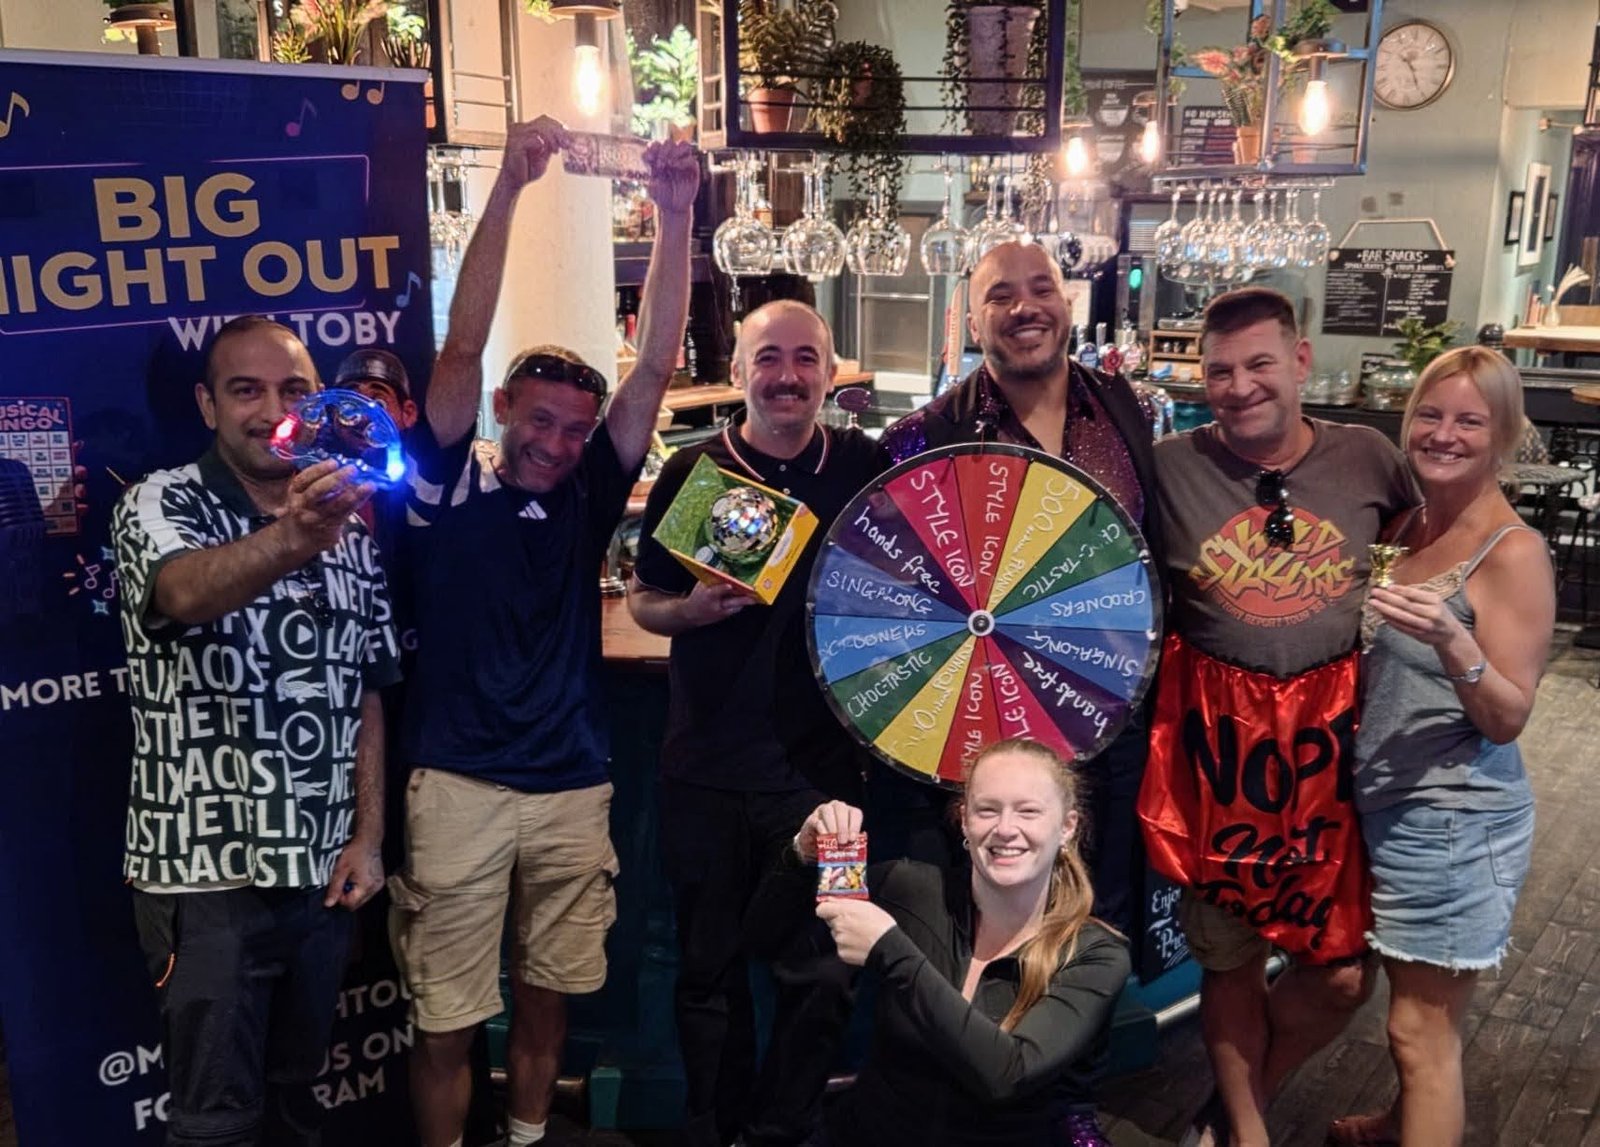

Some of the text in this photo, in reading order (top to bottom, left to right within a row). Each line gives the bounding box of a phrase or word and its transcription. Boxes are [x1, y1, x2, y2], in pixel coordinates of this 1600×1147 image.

[93, 172, 261, 243] BIG
[0, 235, 400, 315] IGHT OUT
[168, 311, 401, 352] WI TOBY
[854, 506, 902, 560] hands
[909, 470, 975, 589] STYLE ICON
[978, 462, 1009, 577] STYLE ICON
[825, 571, 933, 614] SINGALONG
[1026, 629, 1140, 678] SINGALONG
[0, 671, 102, 711] MORE
[964, 673, 984, 720] ICON
[990, 663, 1021, 704] ICON
[1055, 683, 1114, 740] hands
[99, 1042, 164, 1086] @M
[362, 1023, 415, 1061] ON
[311, 1066, 385, 1110] RAM
